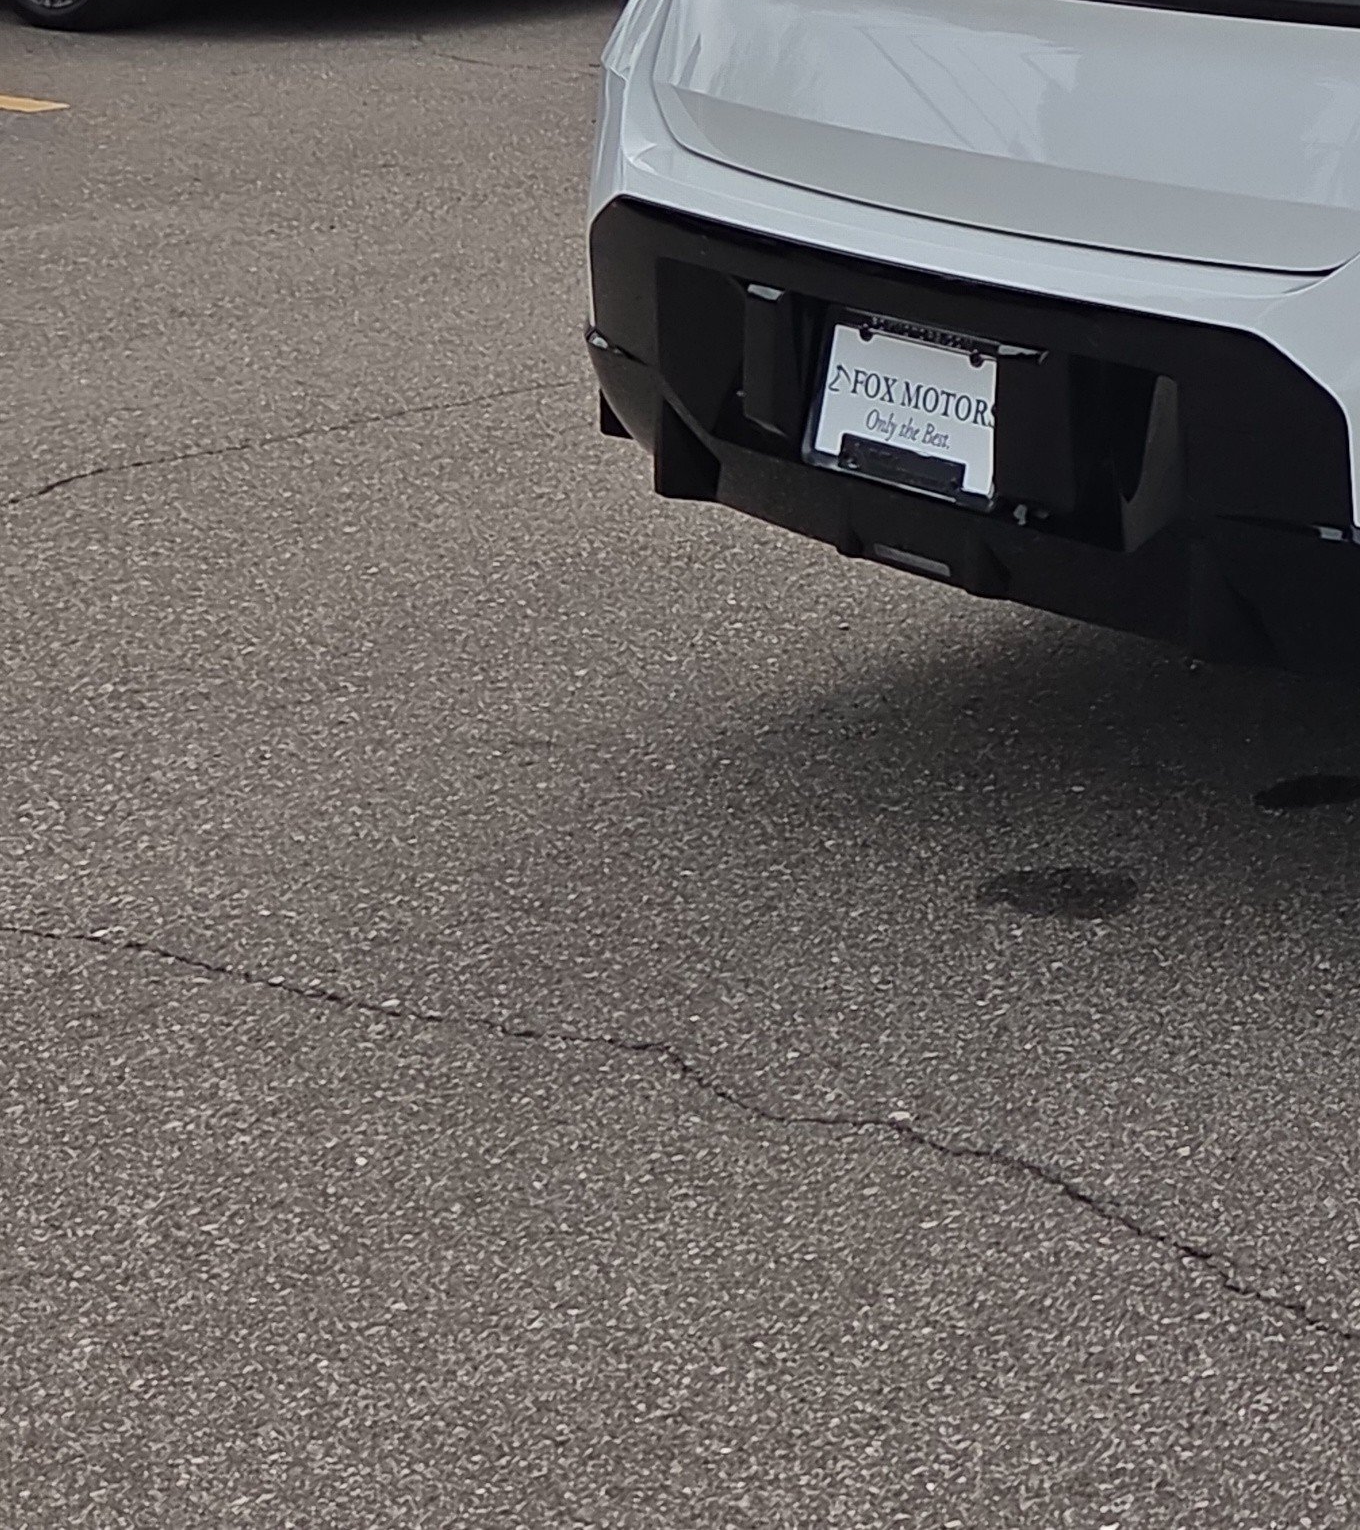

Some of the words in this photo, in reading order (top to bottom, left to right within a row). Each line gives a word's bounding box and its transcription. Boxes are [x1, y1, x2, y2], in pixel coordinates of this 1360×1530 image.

[851, 369, 897, 403] FOX
[866, 409, 897, 441] Only
[899, 417, 920, 441] the
